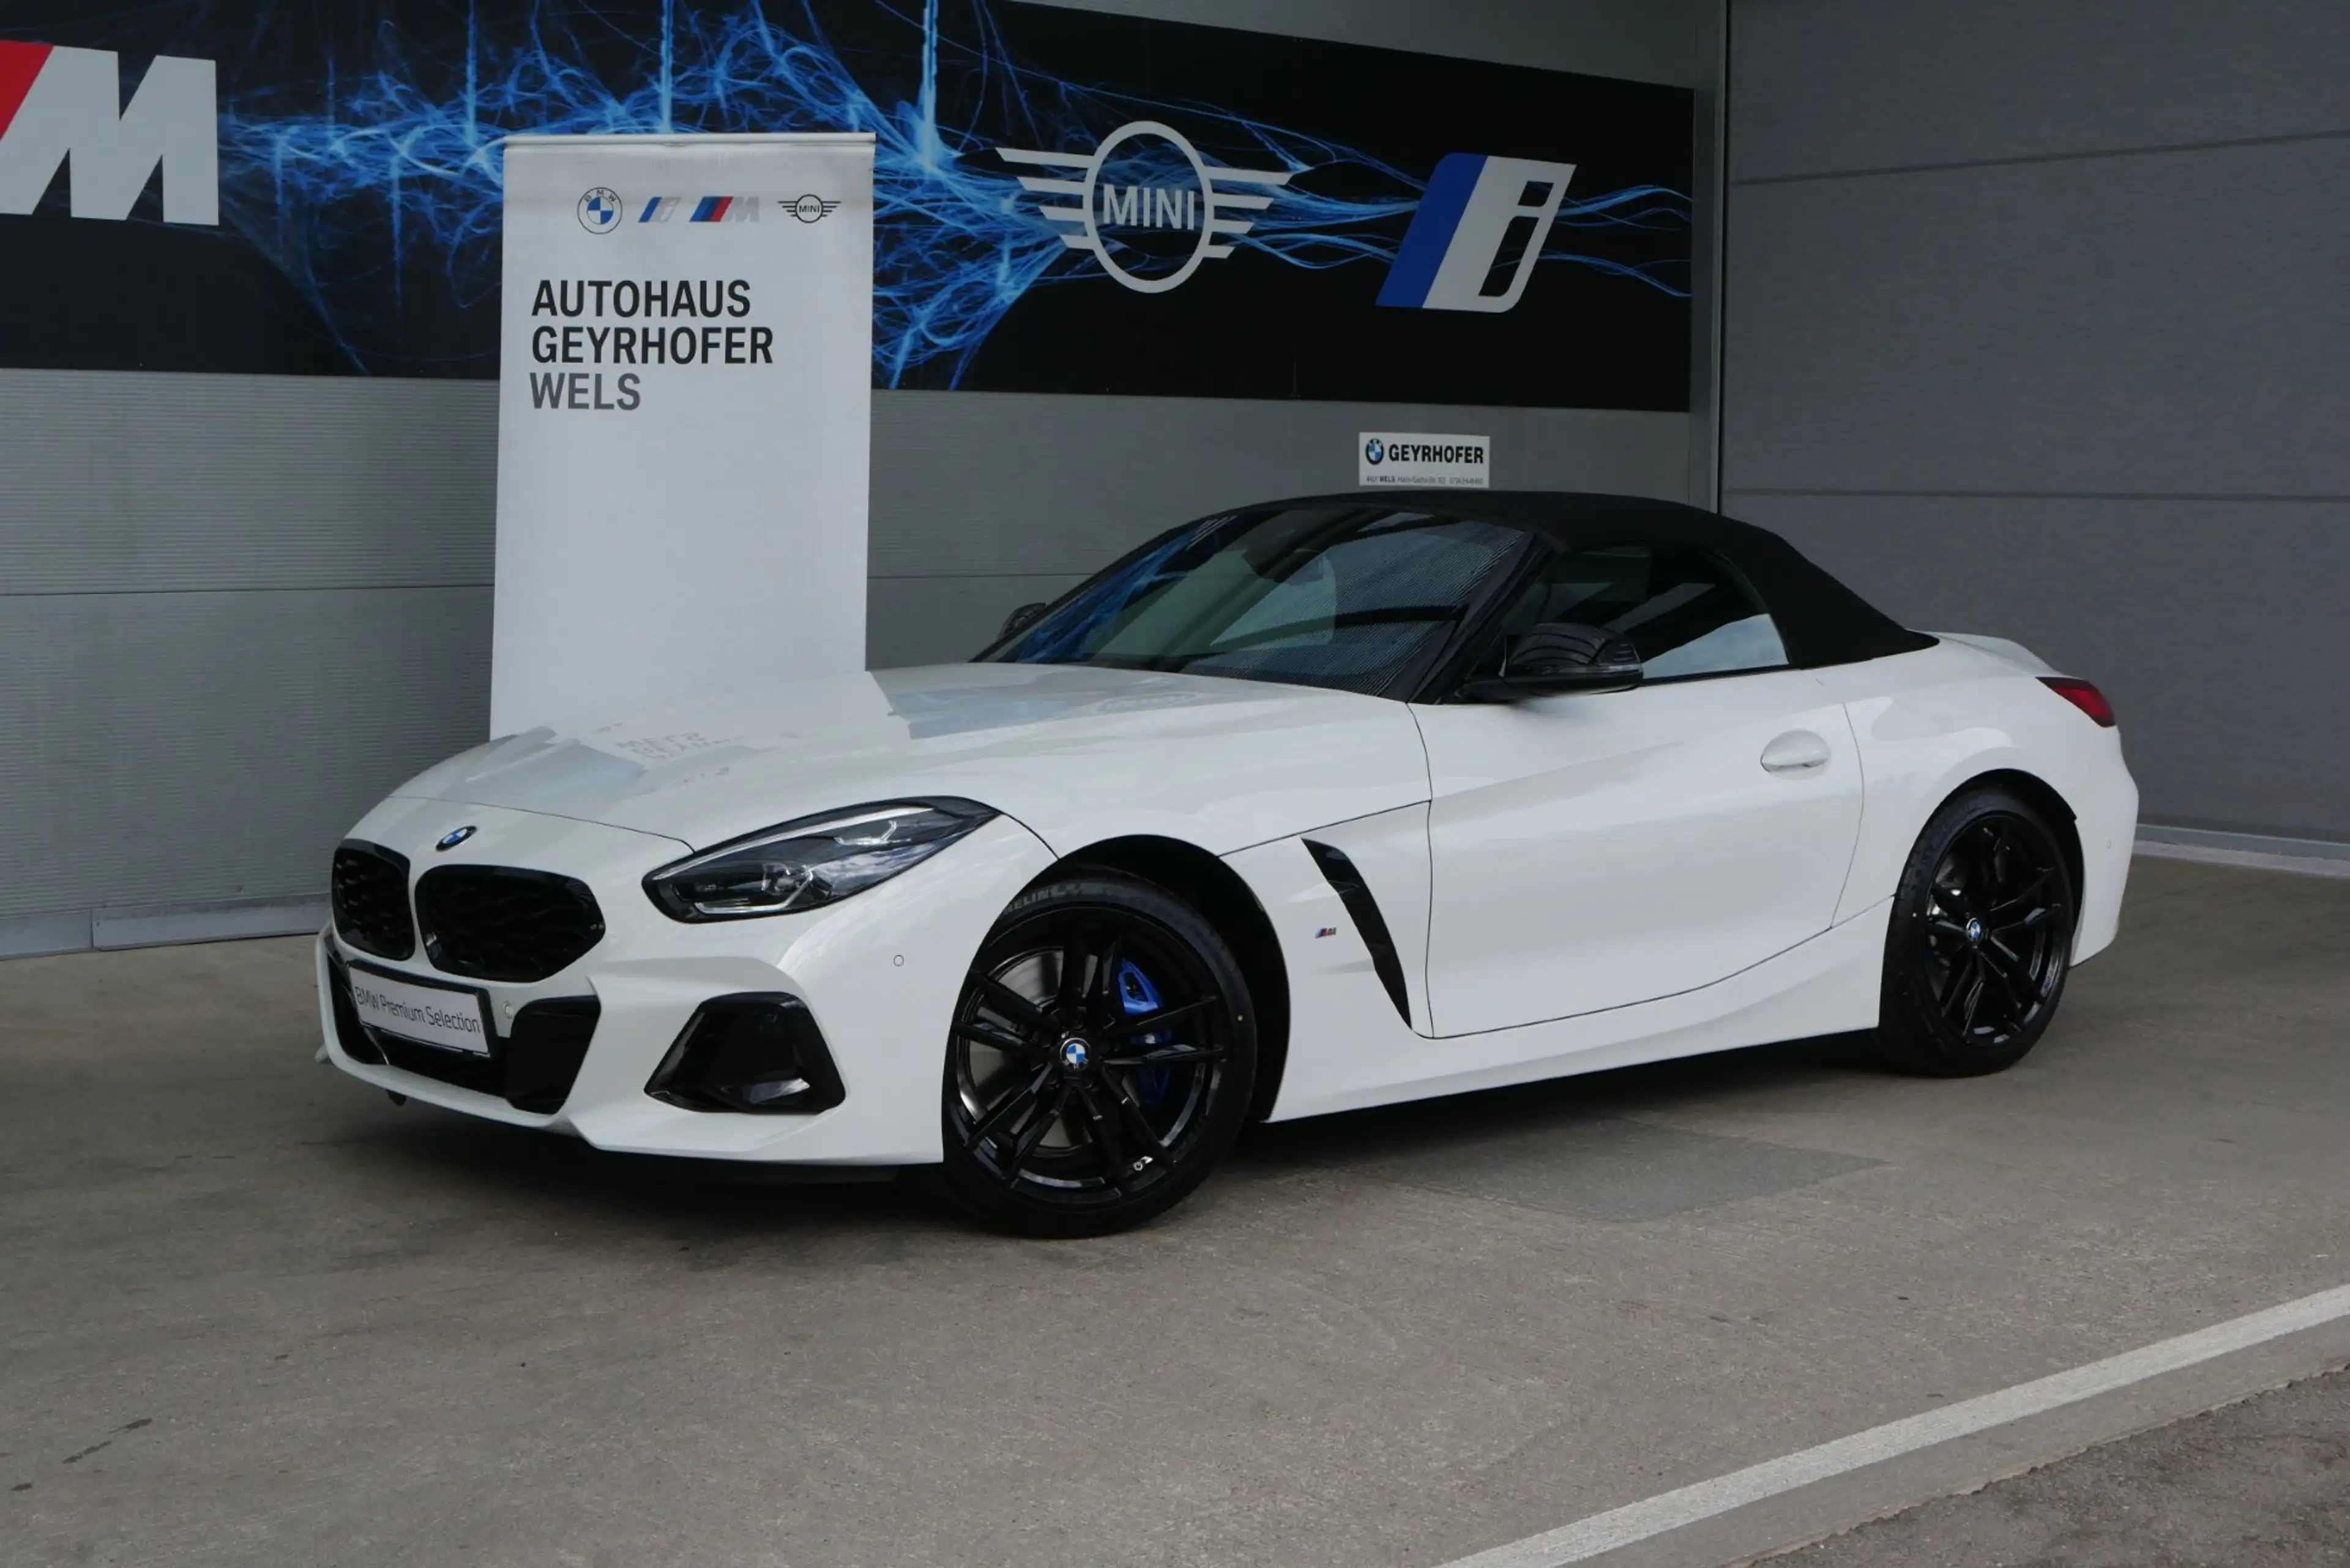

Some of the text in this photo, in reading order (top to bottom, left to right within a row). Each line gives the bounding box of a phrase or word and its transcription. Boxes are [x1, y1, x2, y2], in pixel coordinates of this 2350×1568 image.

[1103, 184, 1195, 231] MINI
[531, 280, 751, 317] AUTOHAUS
[532, 326, 774, 364] GEYRHOFER
[530, 372, 641, 410] WELS
[1389, 444, 1484, 464] GEYRHOFER
[355, 986, 481, 1034] BMW Premium Selection
